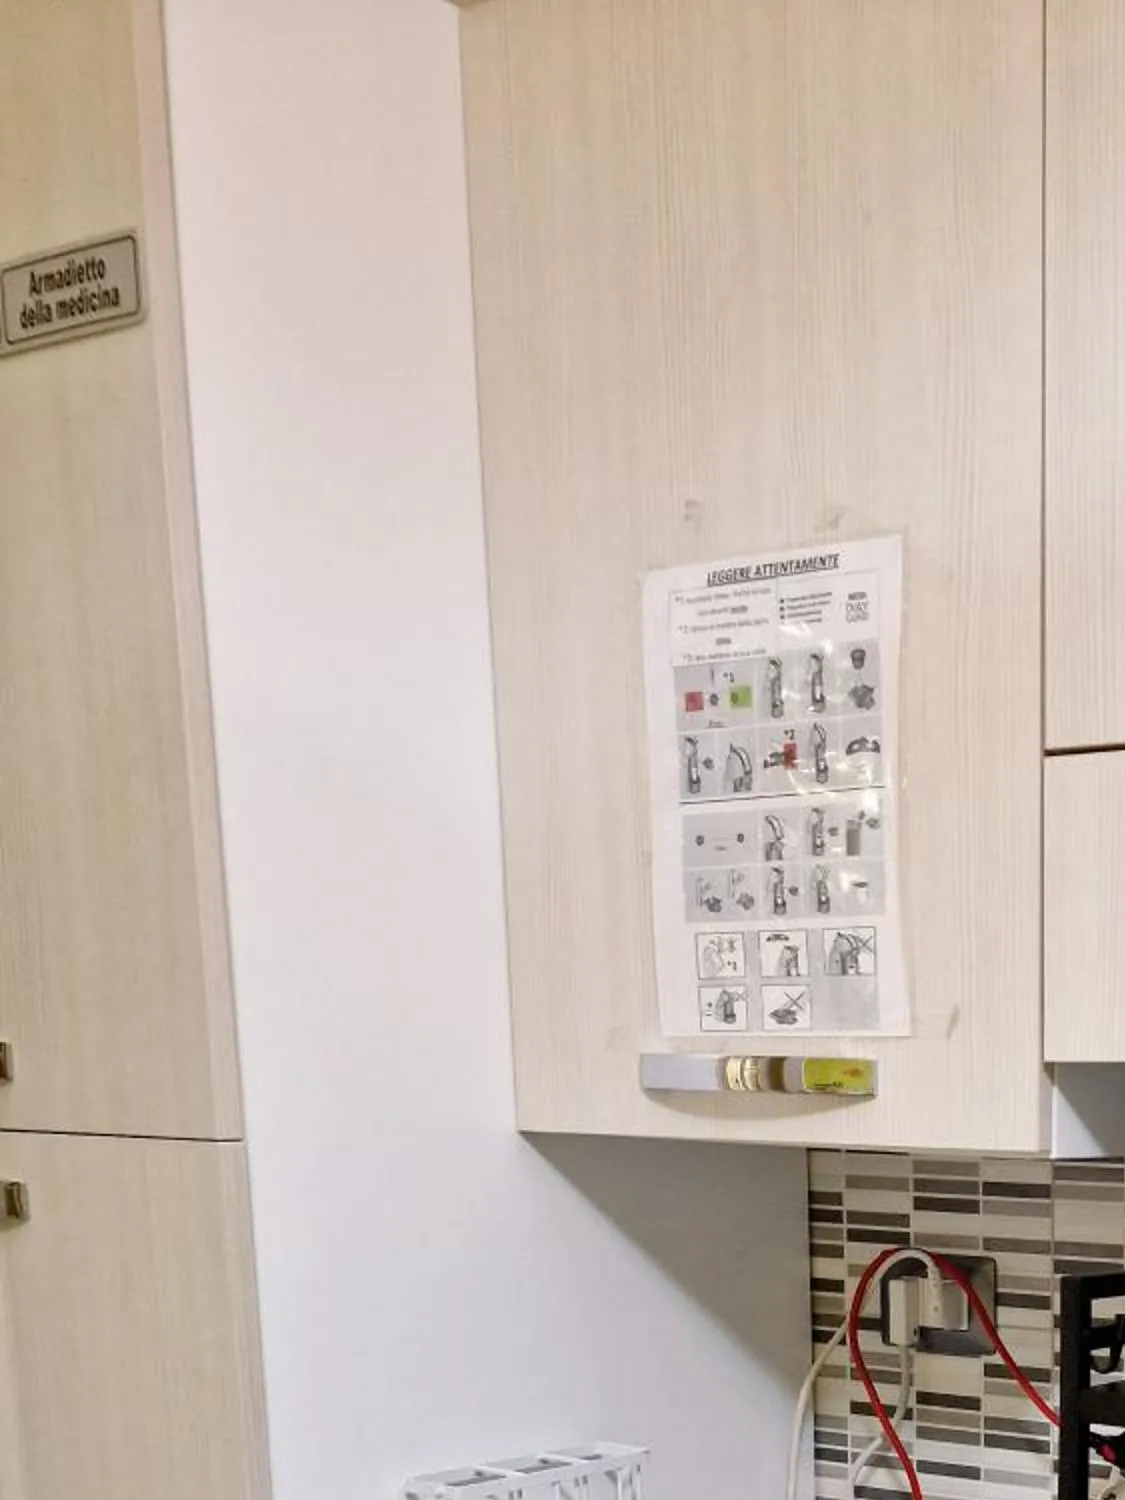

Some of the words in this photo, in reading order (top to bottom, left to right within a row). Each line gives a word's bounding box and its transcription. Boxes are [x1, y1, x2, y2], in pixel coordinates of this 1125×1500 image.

[30, 256, 106, 296] Armadietto
[20, 299, 53, 329] della
[56, 285, 121, 320] medicina
[706, 567, 751, 586] LEGGERE
[753, 553, 841, 577] ATTENTAMENTE
